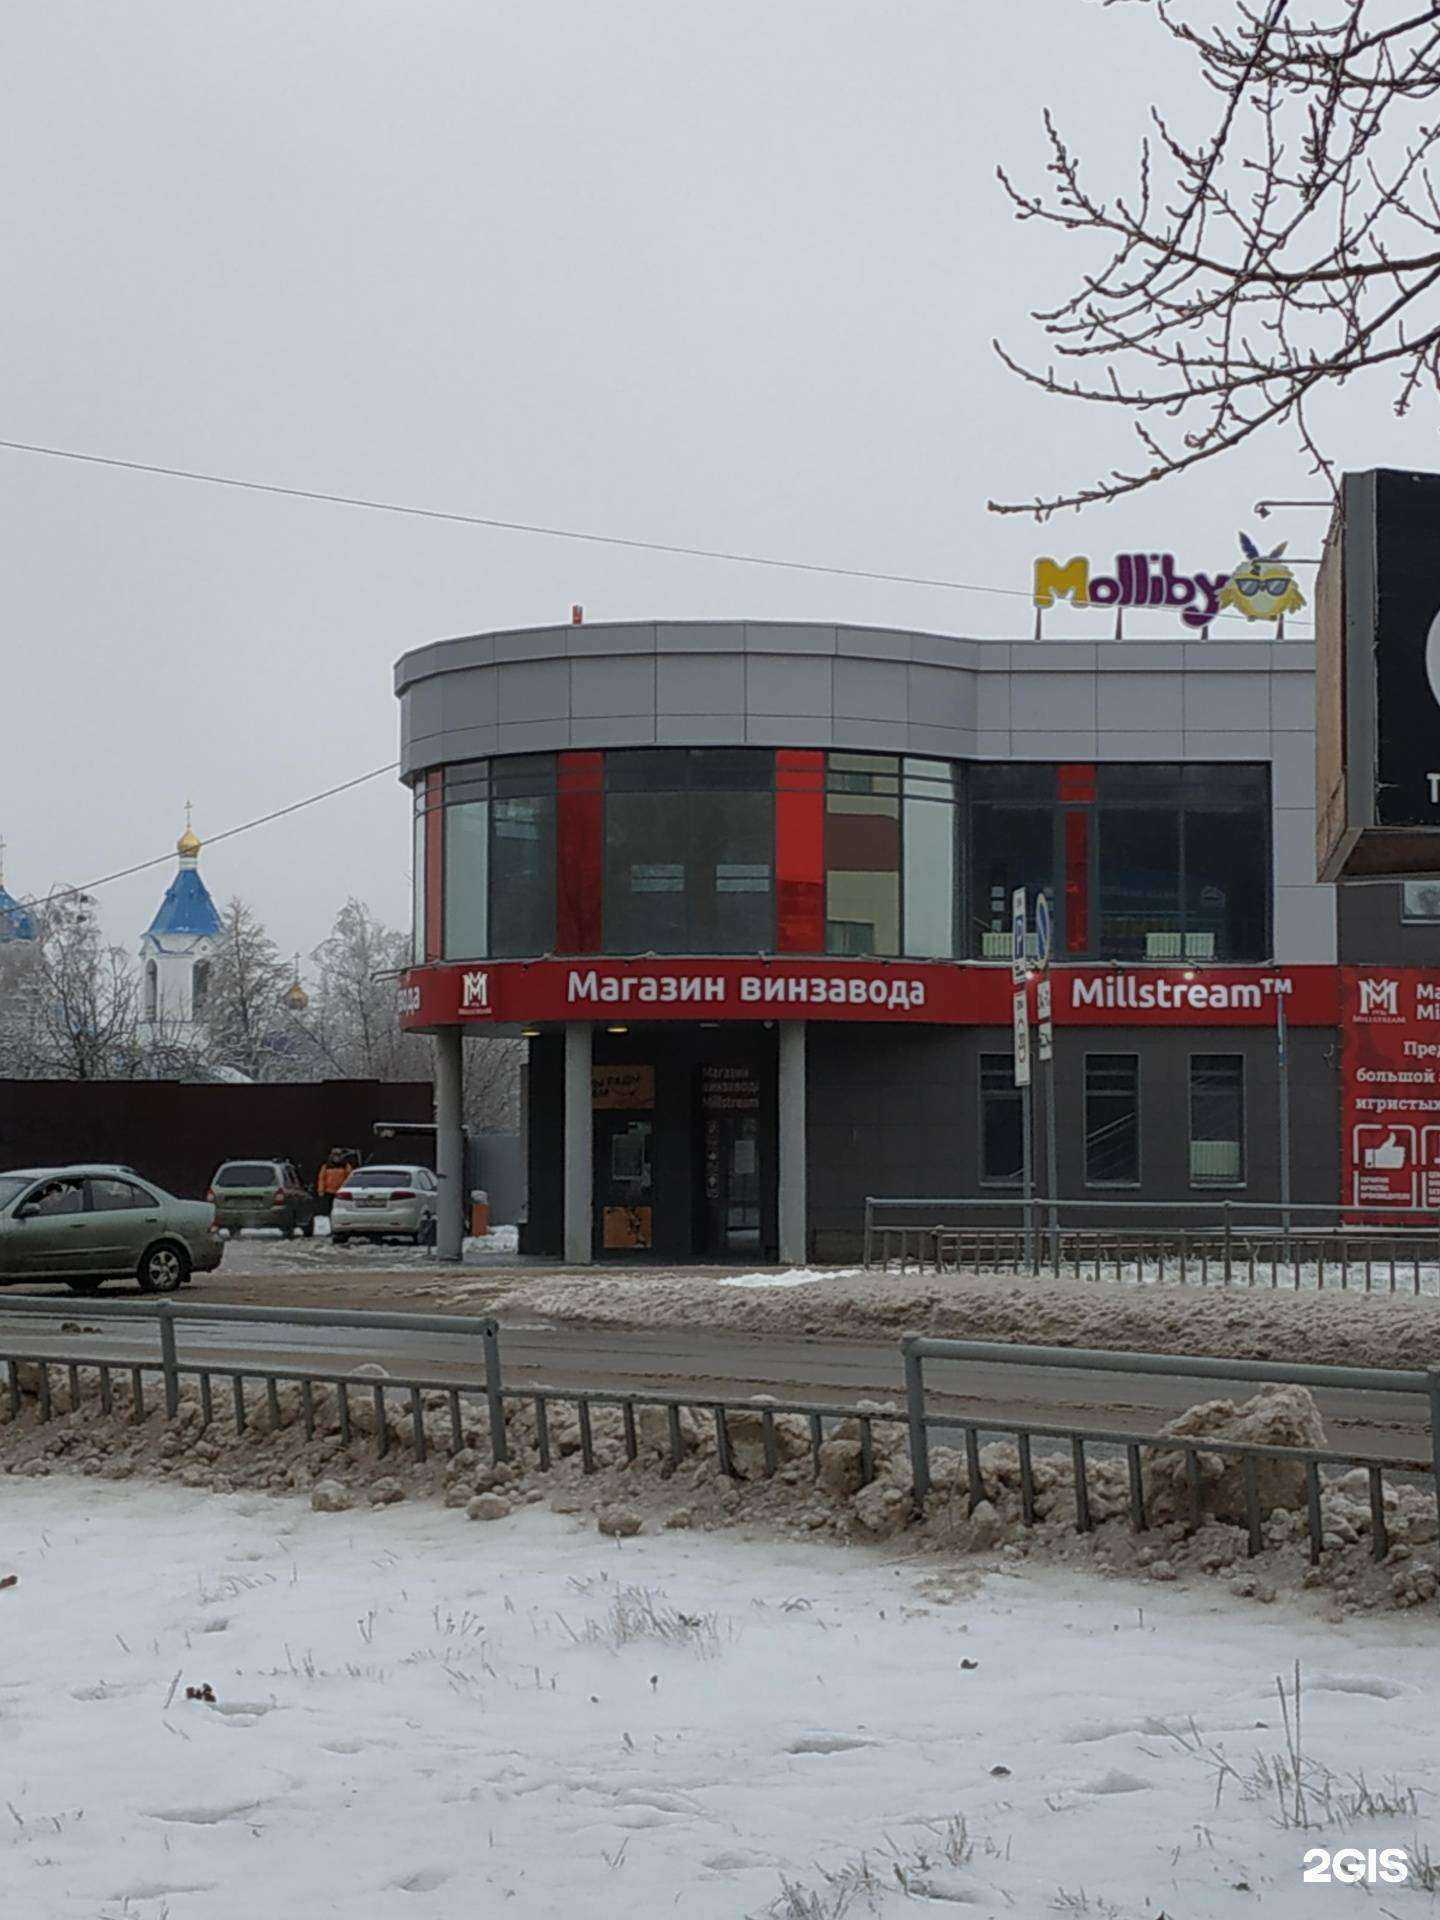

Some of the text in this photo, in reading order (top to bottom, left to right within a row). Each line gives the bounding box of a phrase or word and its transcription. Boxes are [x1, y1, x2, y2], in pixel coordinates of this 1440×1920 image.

[1034, 553, 1230, 626] Molliby
[568, 971, 925, 1010] Магазин винзавода
[1356, 1067, 1435, 1083] большой
